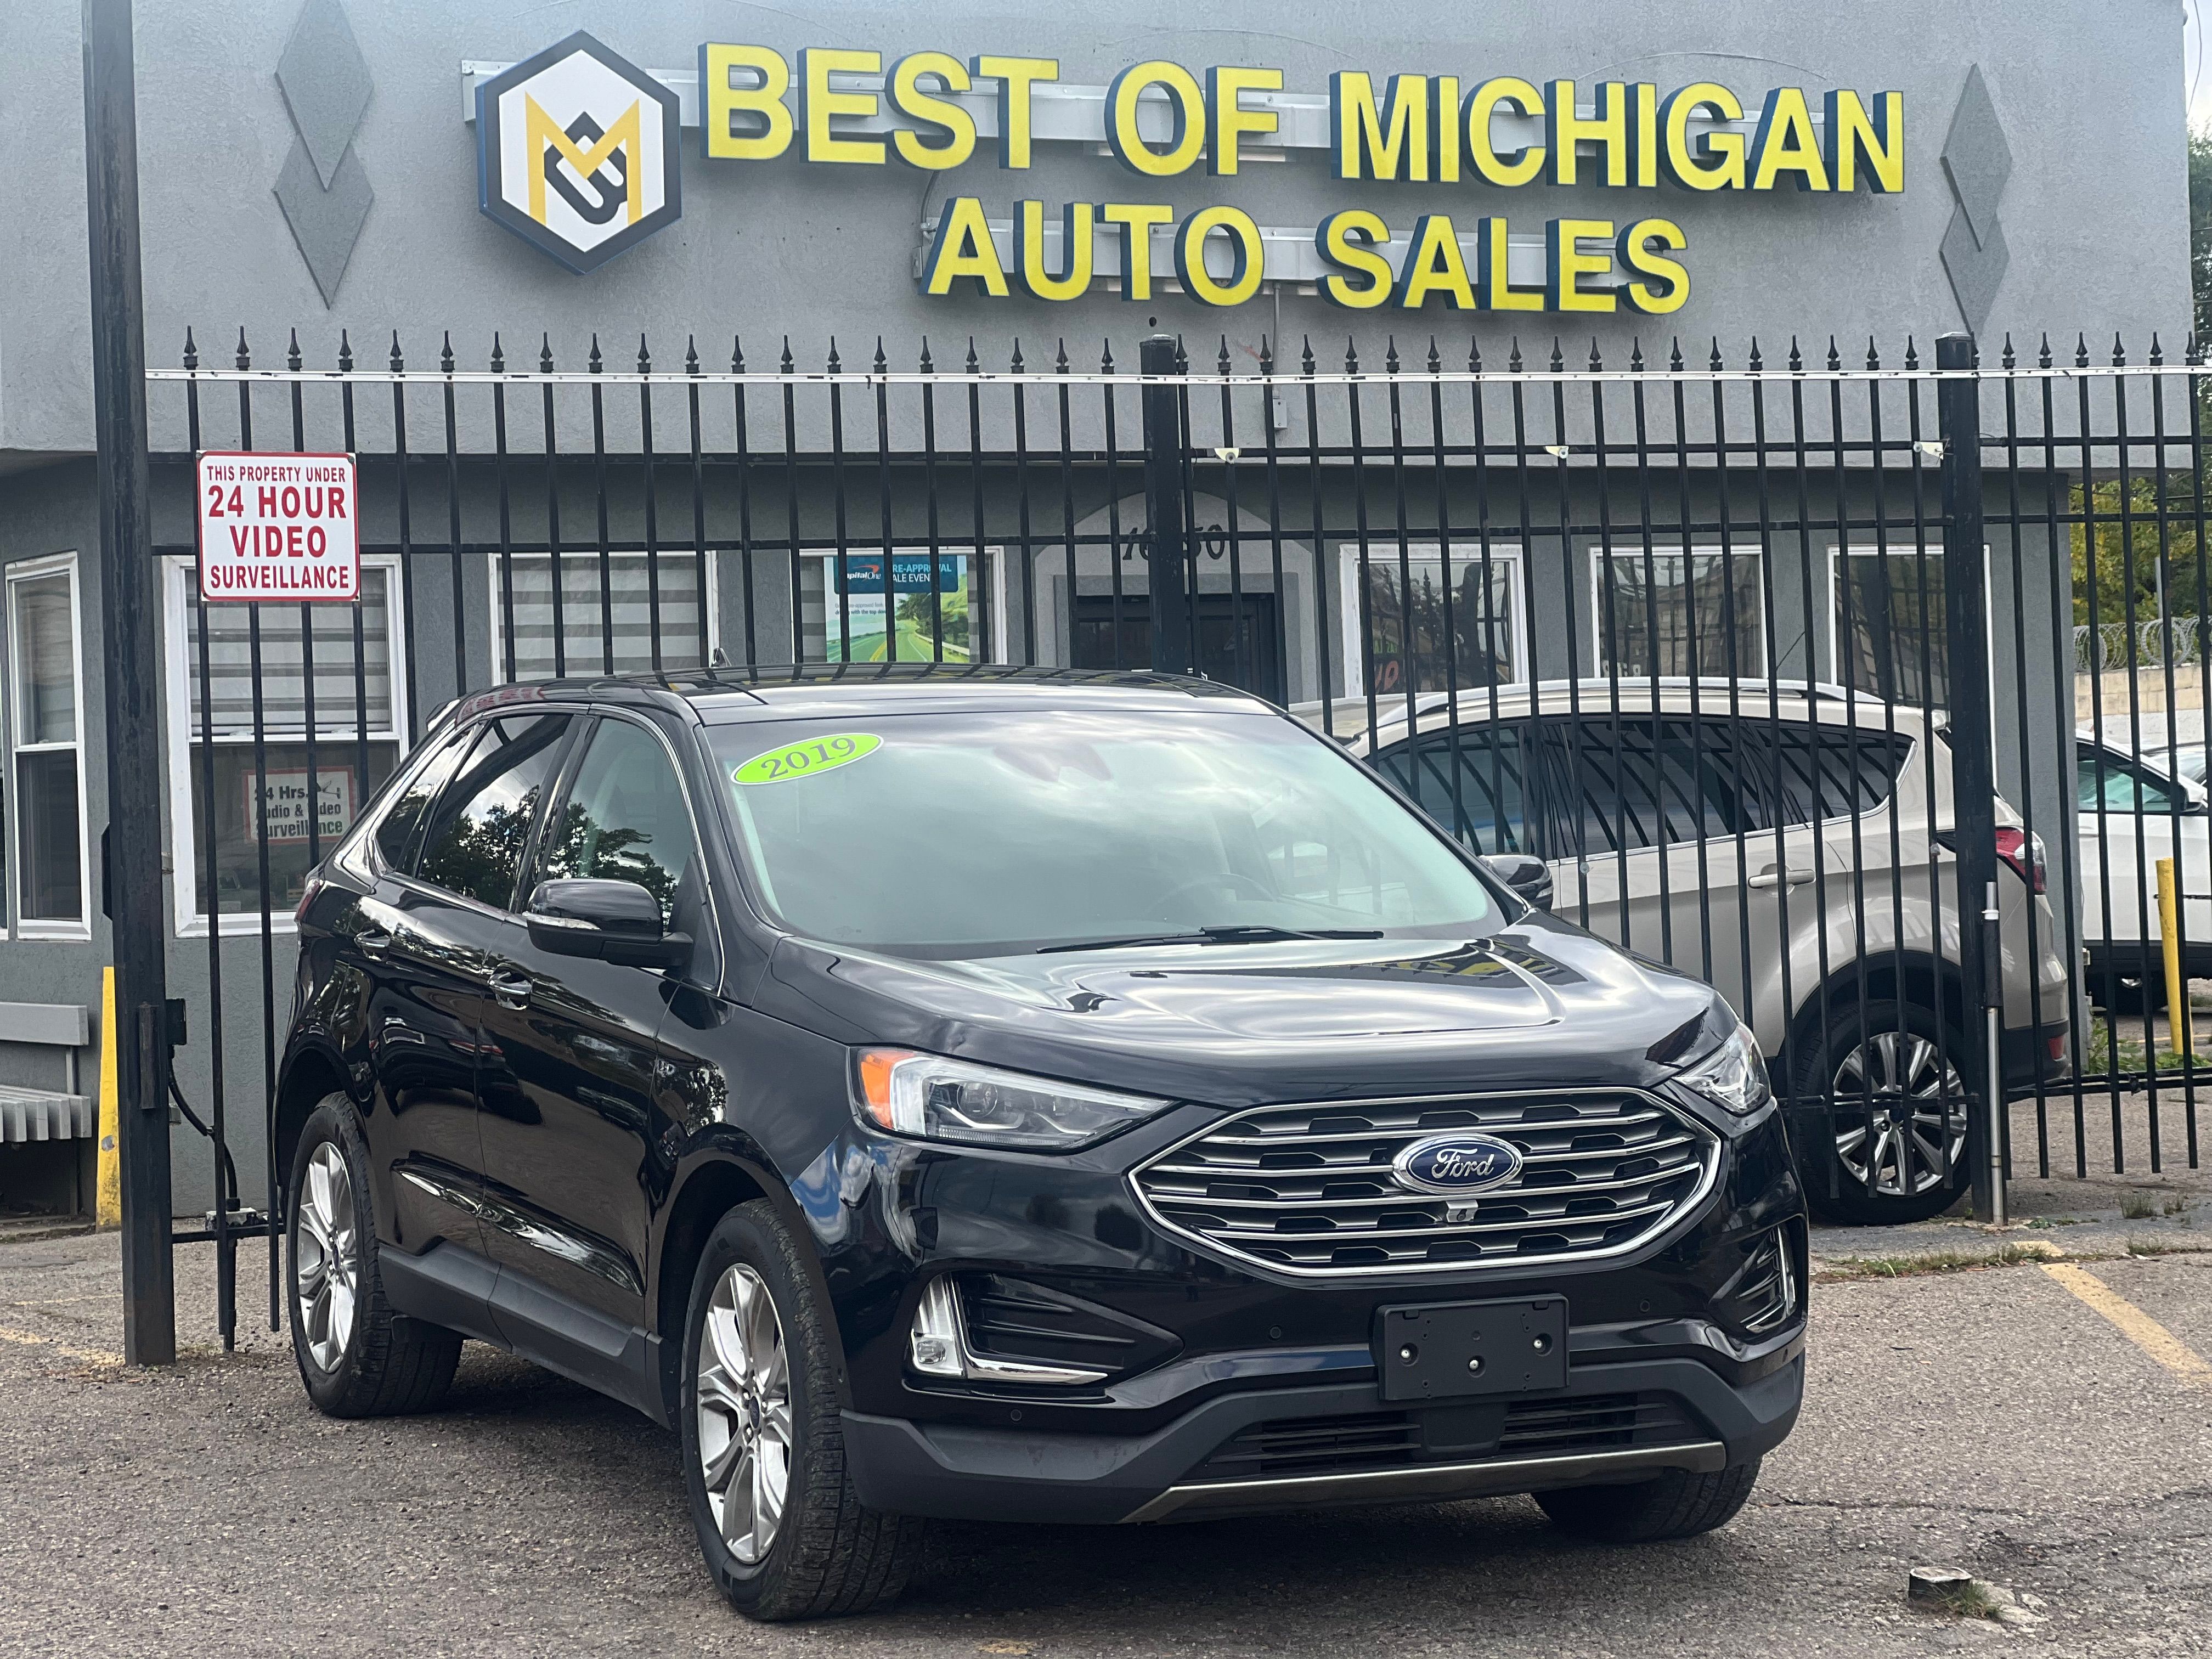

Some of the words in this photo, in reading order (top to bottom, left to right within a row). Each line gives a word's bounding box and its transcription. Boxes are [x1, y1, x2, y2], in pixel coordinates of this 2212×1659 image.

[698, 42, 1059, 170] BEST
[1105, 60, 1284, 176] OF
[1330, 70, 1905, 193] MICHIGAN
[921, 197, 1264, 306] AUTO
[1317, 210, 1690, 314] SALES
[207, 465, 235, 481] THIS
[240, 466, 301, 482] PROPERTY
[306, 467, 346, 482] UNDER
[208, 485, 244, 517] 24
[258, 486, 347, 518] HOUR
[229, 525, 326, 558] VIDEO
[211, 565, 349, 589] SURVEILLANCE
[892, 563, 952, 573] RE-APPRAL
[892, 574, 906, 583] ALE
[909, 573, 931, 582] EVEN
[760, 737, 856, 779] 2019
[279, 786, 309, 800] Hrs.
[294, 803, 304, 817] &
[1431, 1148, 1495, 1179] Ford
